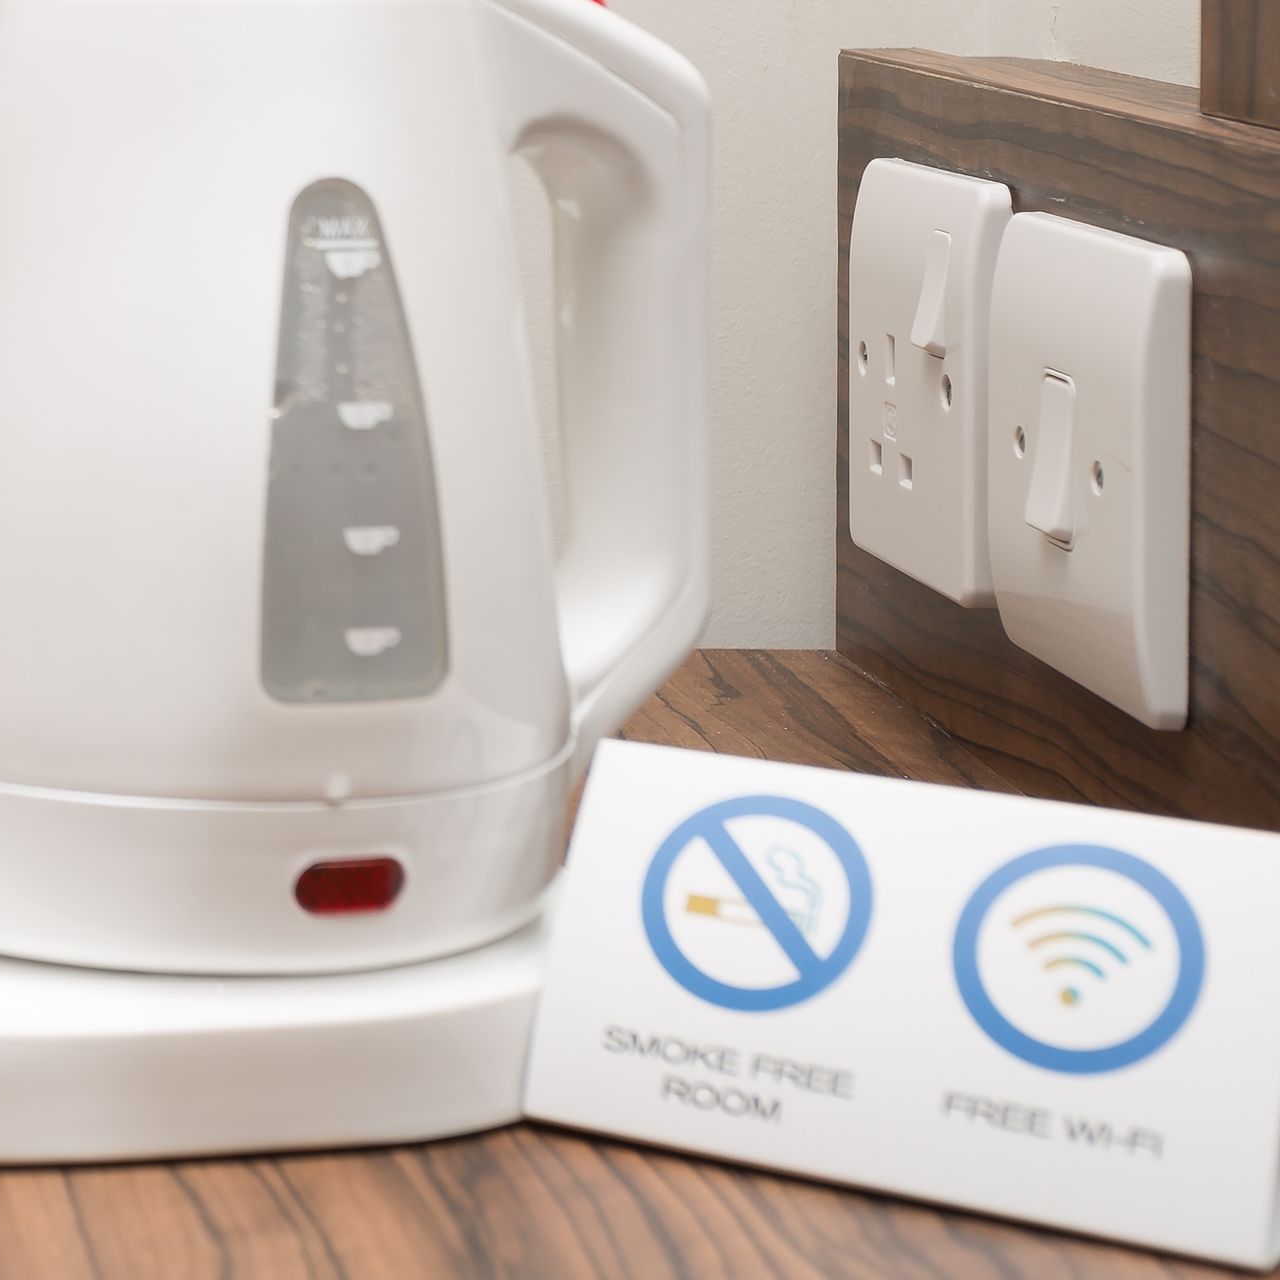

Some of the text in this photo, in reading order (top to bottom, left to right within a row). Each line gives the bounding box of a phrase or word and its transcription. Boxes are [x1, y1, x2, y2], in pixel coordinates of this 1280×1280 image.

[600, 1024, 857, 1102] SMOKE FREE
[660, 1073, 783, 1126] ROOM
[940, 1089, 1165, 1160] FREE WI-FI
